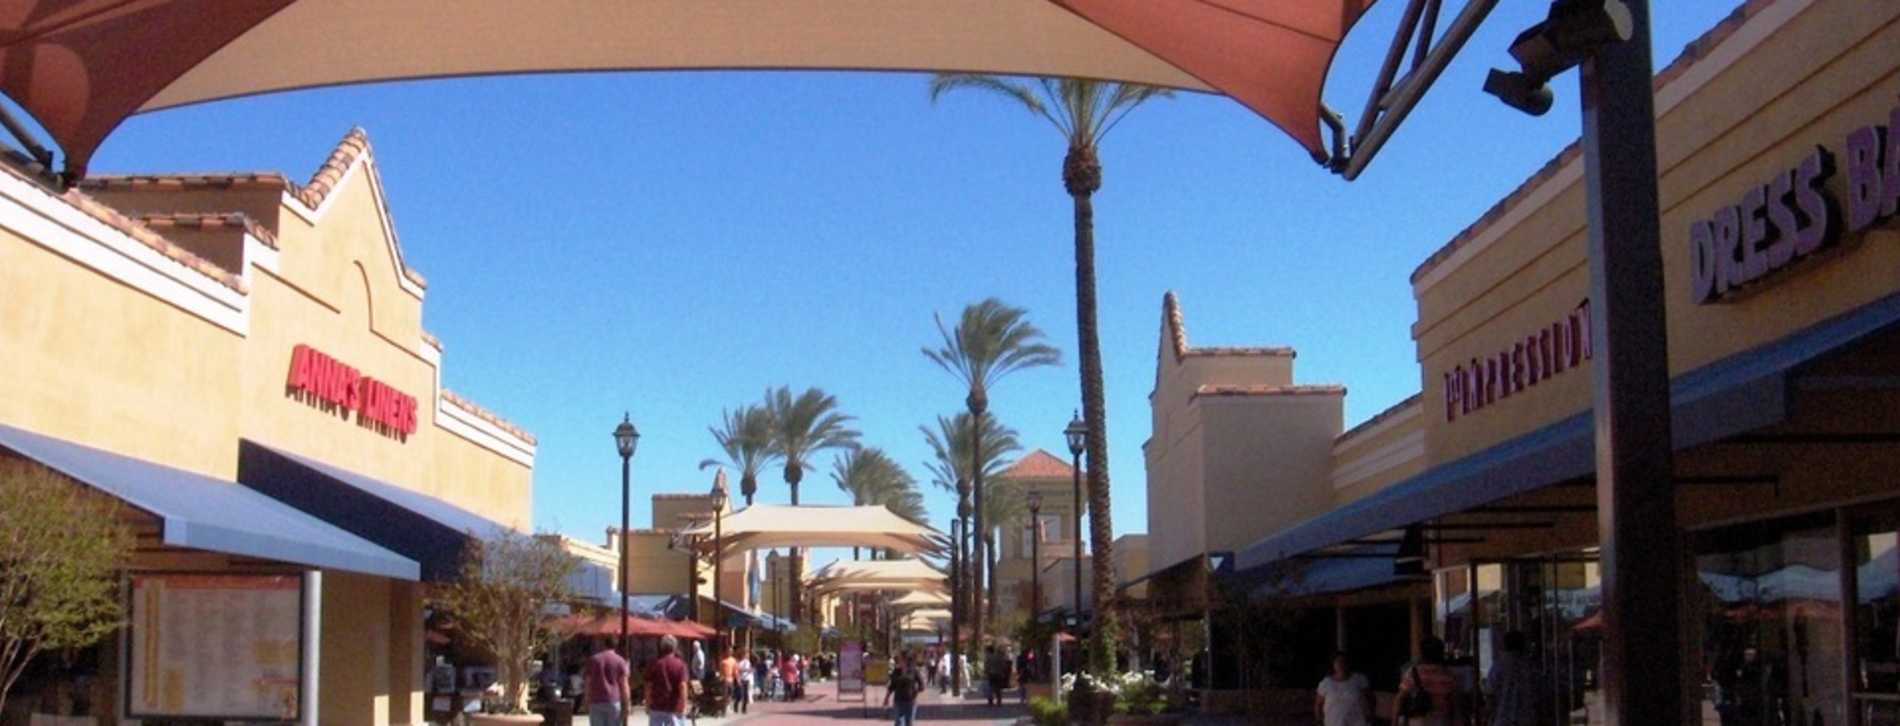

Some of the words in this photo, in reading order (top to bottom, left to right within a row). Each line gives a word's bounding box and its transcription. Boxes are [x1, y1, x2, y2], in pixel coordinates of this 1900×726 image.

[1690, 146, 1828, 305] DRESS
[288, 344, 361, 412] ANNA'S
[360, 376, 417, 434] LINENS
